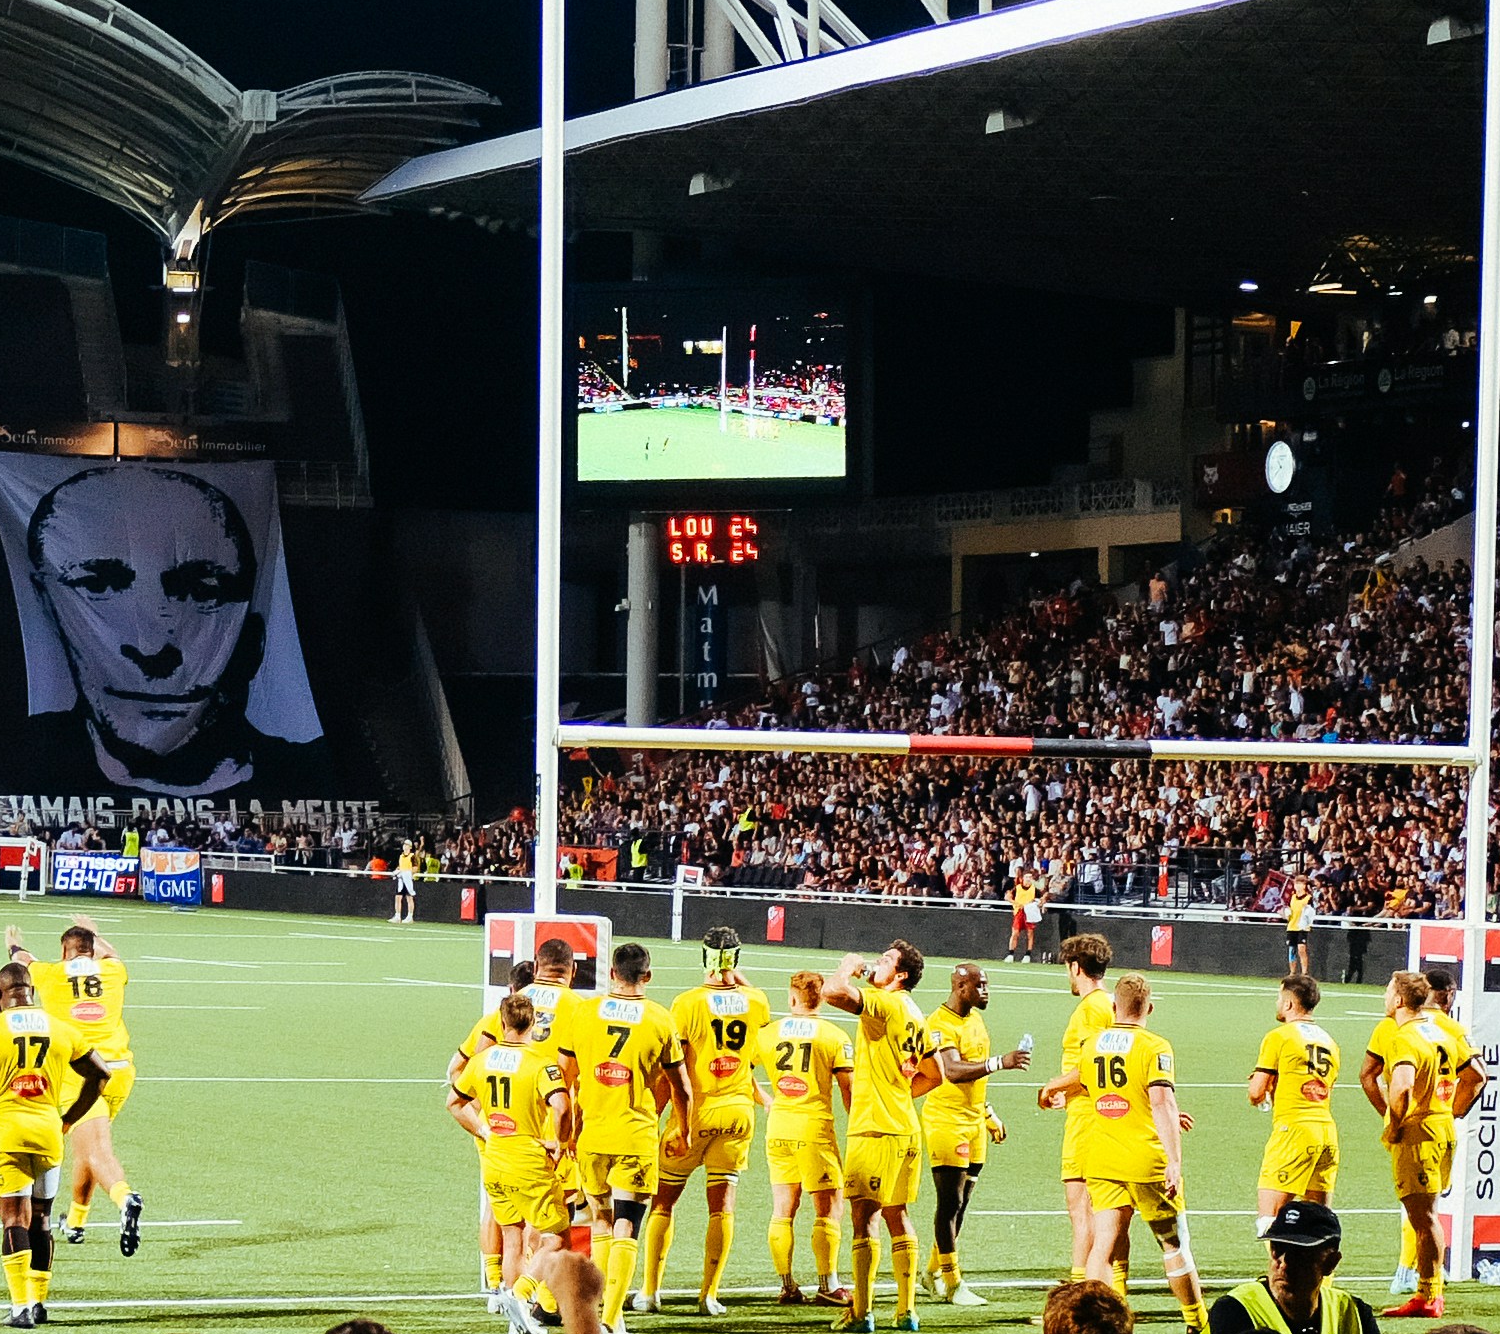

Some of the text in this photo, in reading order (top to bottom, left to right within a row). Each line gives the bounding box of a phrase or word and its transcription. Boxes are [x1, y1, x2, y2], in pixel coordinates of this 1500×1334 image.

[670, 517, 713, 536] LOU
[698, 585, 719, 709] Matm
[9, 795, 115, 828] JAMAIS
[81, 857, 140, 872] TISSOT
[159, 880, 197, 898] GMF
[67, 975, 103, 999] 18
[607, 1025, 631, 1058] 7
[710, 1018, 747, 1051] 19
[13, 1036, 51, 1069] 17
[776, 1041, 813, 1073] 21
[1304, 1043, 1332, 1077] 15
[1094, 1055, 1128, 1089] 16
[487, 1075, 511, 1109] 11
